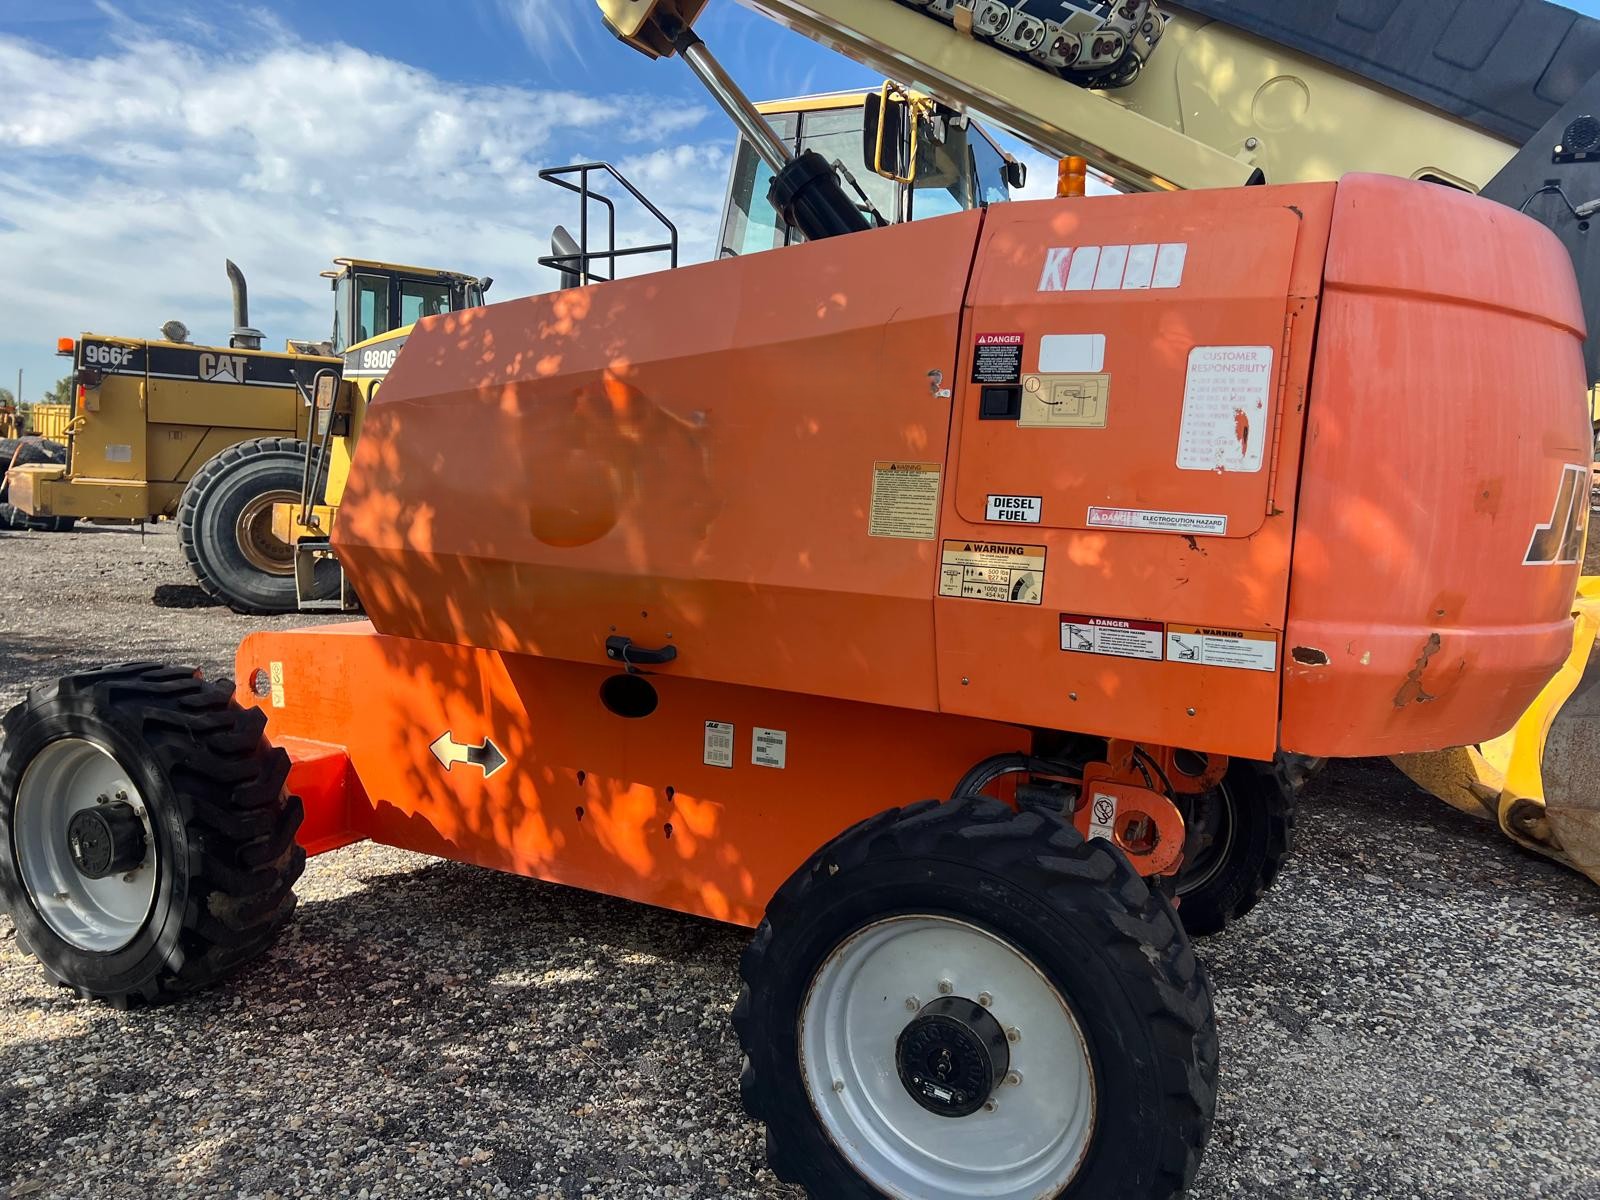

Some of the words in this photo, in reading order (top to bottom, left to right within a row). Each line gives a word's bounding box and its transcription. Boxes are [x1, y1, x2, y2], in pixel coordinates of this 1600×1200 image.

[987, 335, 1021, 344] DANGER
[86, 345, 134, 365] 966F
[363, 349, 397, 369] 980G
[1203, 352, 1257, 361] CUSTOMER
[199, 353, 248, 383] CAT
[1191, 364, 1267, 373] RESPONSIBILITY
[993, 497, 1035, 509] DIESEL
[998, 510, 1028, 521] FUEL
[1142, 515, 1195, 525] ELECTROCUTION
[1195, 519, 1223, 527] HAZARD
[974, 544, 1024, 555] WARNING
[1095, 619, 1129, 628] DANGER
[1202, 629, 1244, 638] WARNING
